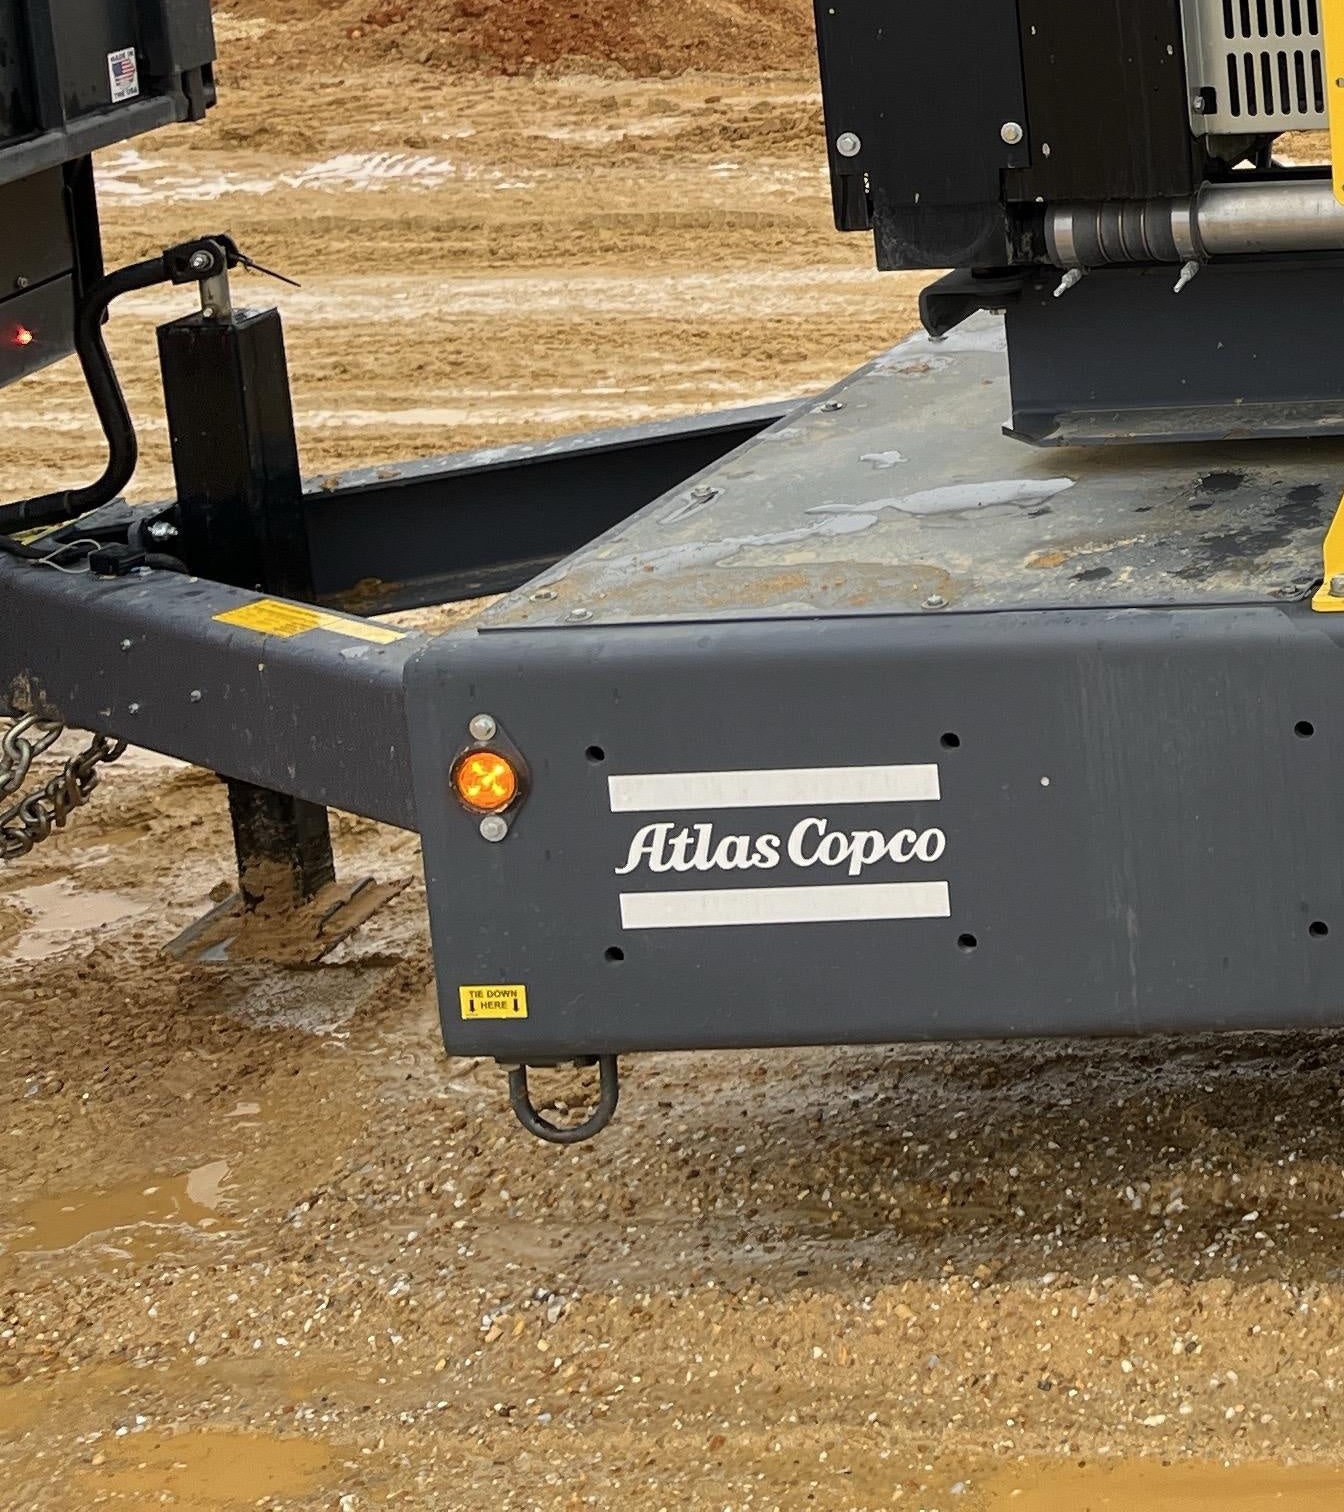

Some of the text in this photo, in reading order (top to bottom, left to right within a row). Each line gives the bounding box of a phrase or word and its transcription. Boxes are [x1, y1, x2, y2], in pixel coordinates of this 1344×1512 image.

[614, 817, 946, 876] Atlas Copco
[469, 989, 518, 999] TIE DOWN
[480, 1000, 508, 1010] HERE
